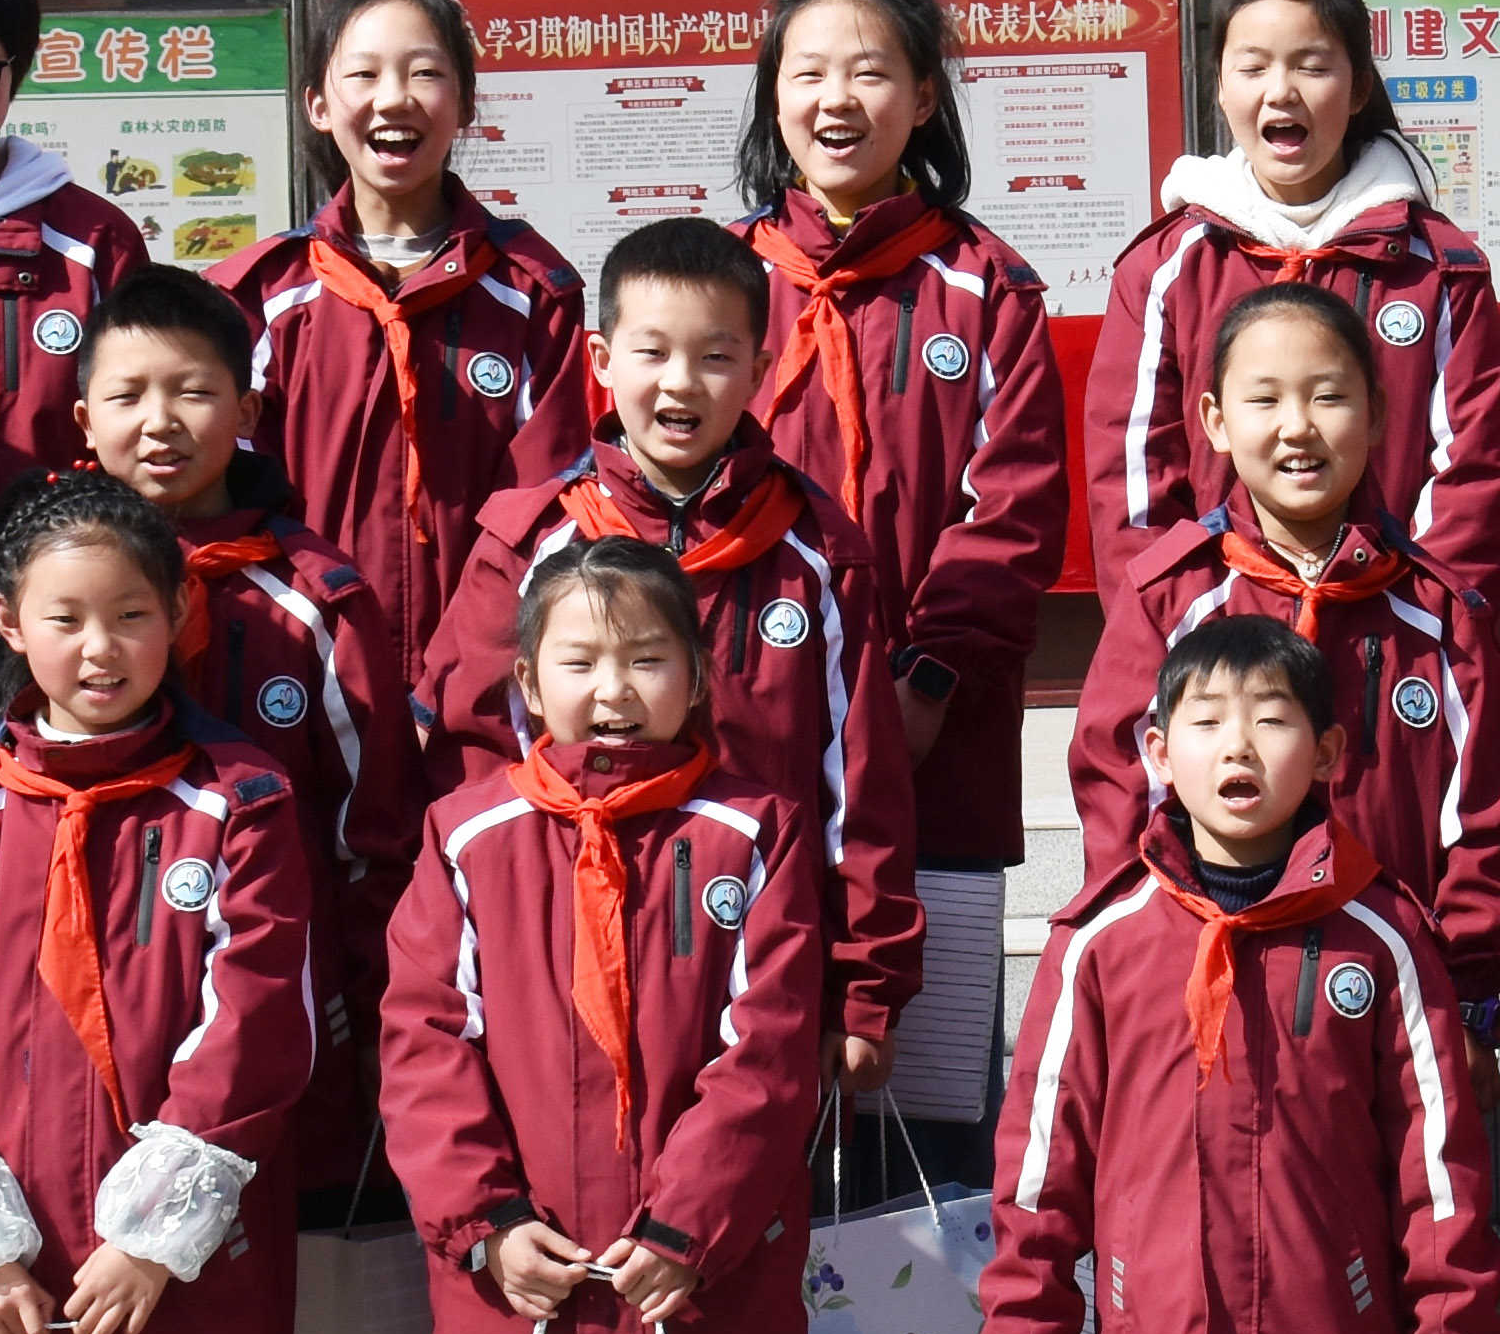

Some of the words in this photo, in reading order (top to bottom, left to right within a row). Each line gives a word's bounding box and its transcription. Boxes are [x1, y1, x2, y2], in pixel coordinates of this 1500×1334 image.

[32, 25, 217, 83] 宣传栏
[1396, 80, 1466, 99] 垃圾分类
[121, 119, 226, 134] 森林火灾的预防
